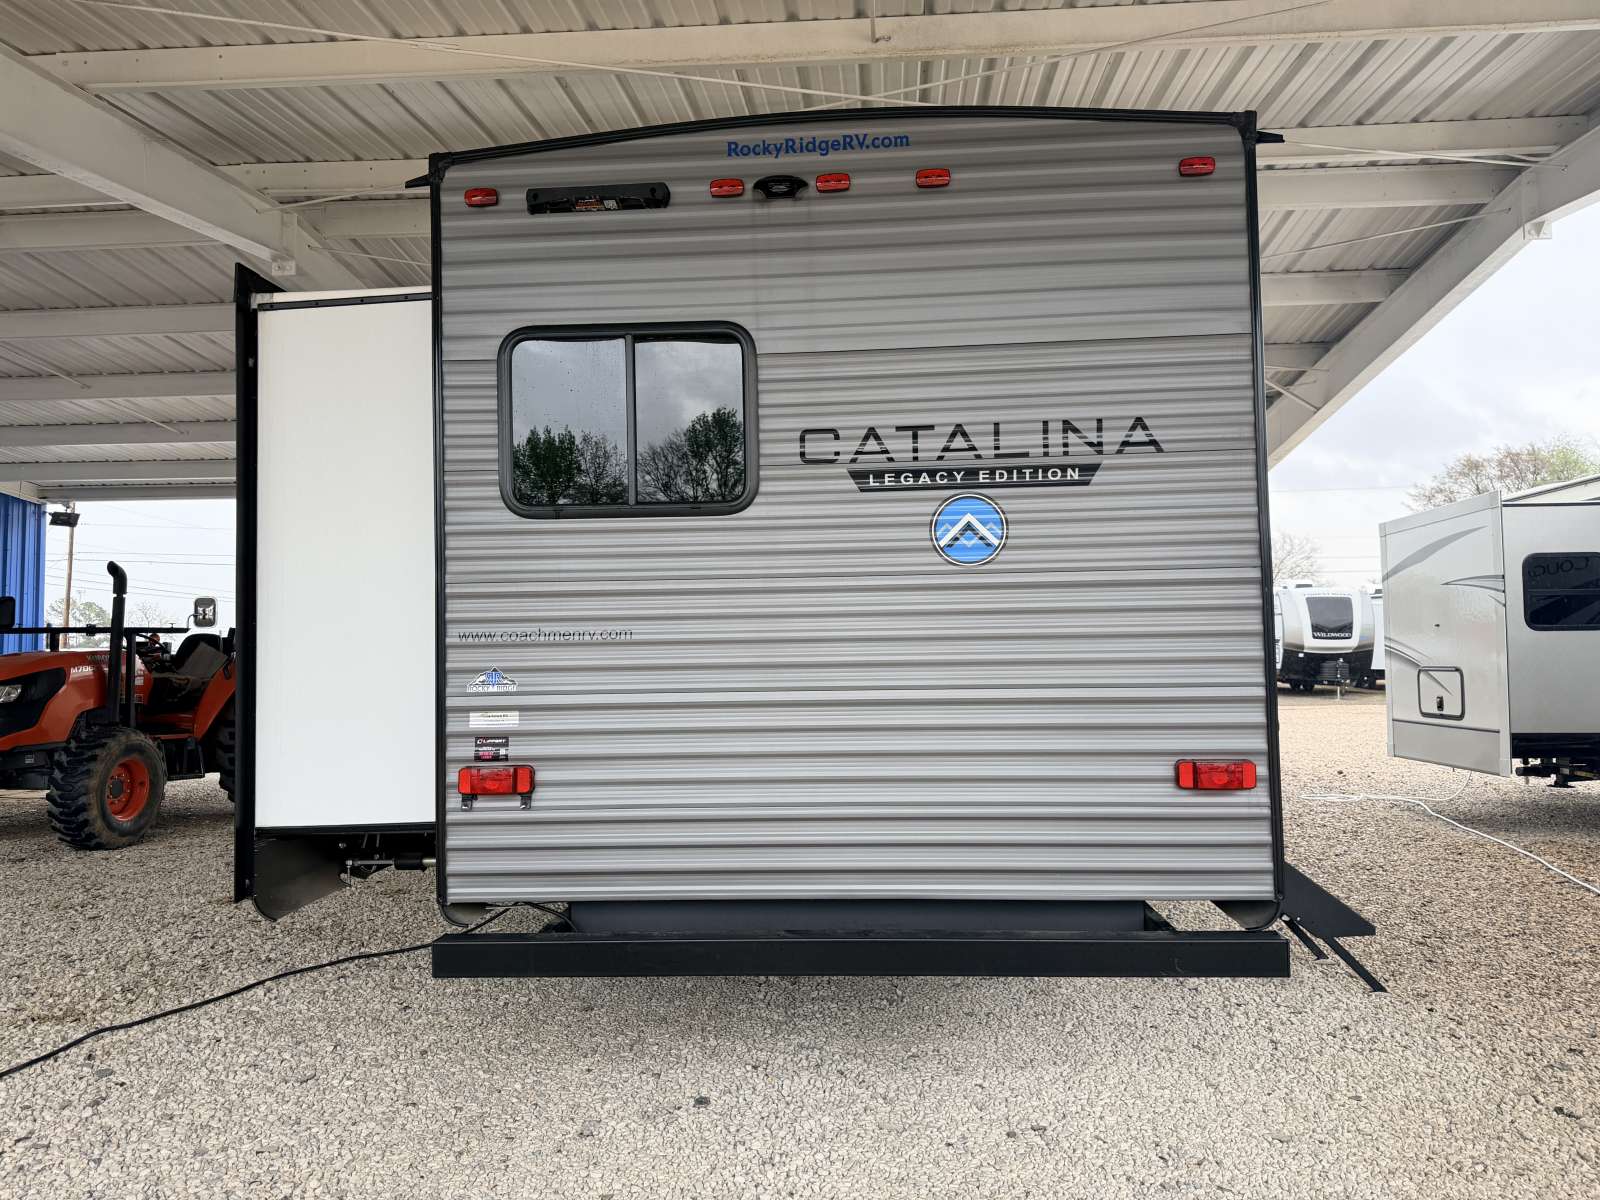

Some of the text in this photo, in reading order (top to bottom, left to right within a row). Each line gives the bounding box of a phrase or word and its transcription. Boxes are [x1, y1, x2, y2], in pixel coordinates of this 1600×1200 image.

[727, 133, 910, 158] RockyRidgeRV.com
[799, 415, 1165, 464] CATALINA
[869, 467, 1080, 486] LEGACY EDITION
[457, 627, 633, 642] www.coachmenrv.com
